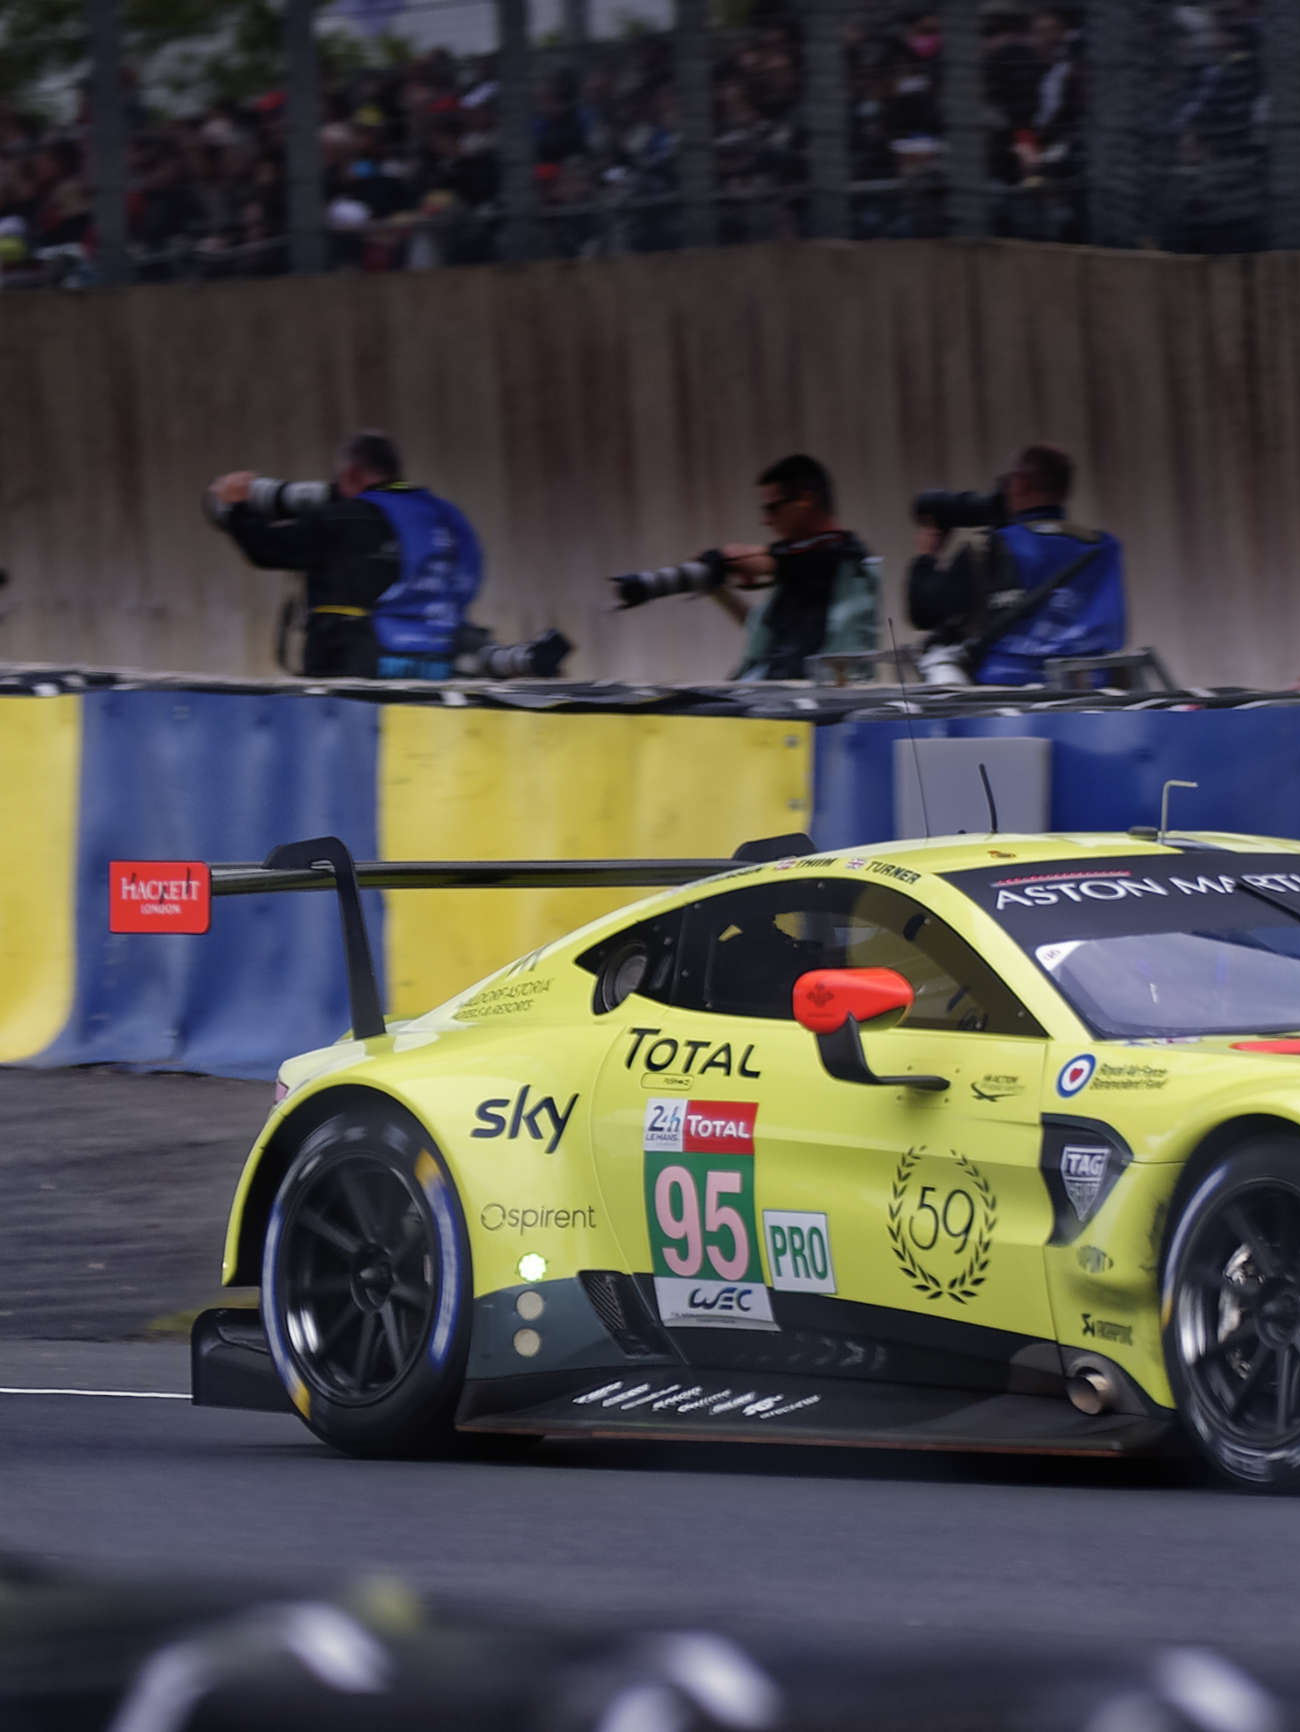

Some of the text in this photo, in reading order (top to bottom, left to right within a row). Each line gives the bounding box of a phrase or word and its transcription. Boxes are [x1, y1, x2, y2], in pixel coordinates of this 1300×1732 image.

[865, 861, 921, 885] TURNER
[121, 877, 201, 901] HACKETT
[996, 877, 1168, 910] ASTON
[140, 903, 182, 915] LONDON
[624, 1027, 762, 1079] TOTAL
[470, 1084, 579, 1154] sky
[687, 1114, 751, 1139] TOTAL
[1066, 1153, 1105, 1176] TAG
[655, 1165, 749, 1281] 95
[909, 1186, 975, 1255] 59
[770, 1225, 828, 1281] PRO
[688, 1286, 753, 1312] WEC
